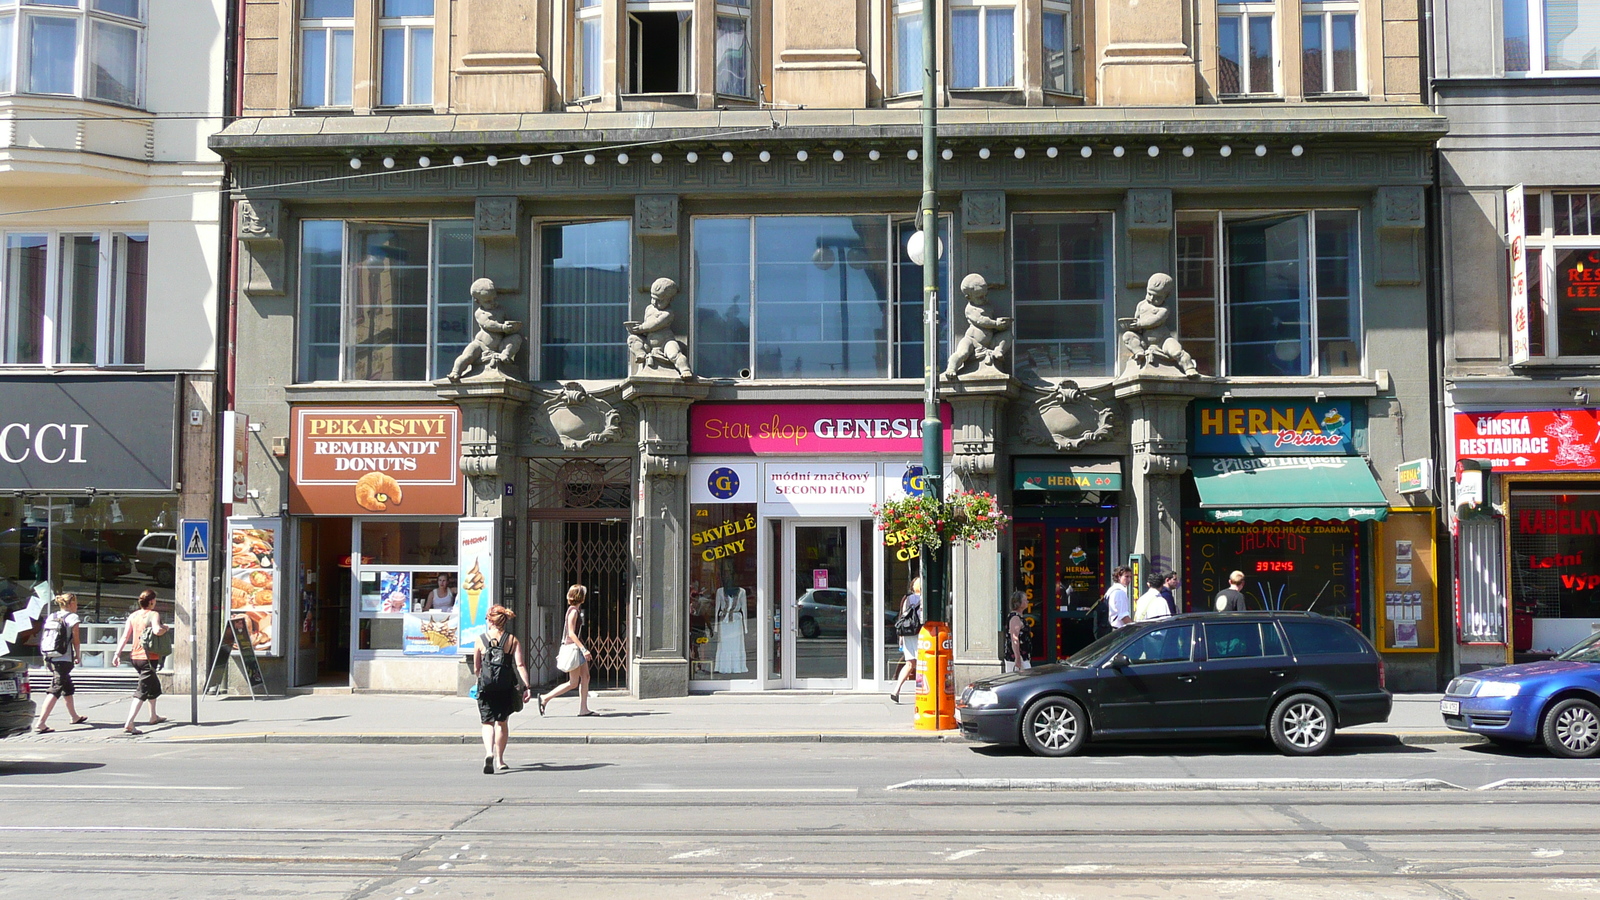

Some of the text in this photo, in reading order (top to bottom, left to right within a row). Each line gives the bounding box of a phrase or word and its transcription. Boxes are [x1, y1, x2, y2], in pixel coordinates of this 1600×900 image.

[309, 415, 446, 435] PEKAŘSTVÍ
[1200, 406, 1323, 436] HERNA
[1476, 416, 1531, 435] ČÍNSKÁ
[704, 418, 752, 439] Star
[758, 414, 808, 446] shop
[1274, 429, 1342, 448] Primo
[0, 422, 89, 464] CCI
[314, 441, 440, 455] REMBRANDT
[1459, 438, 1549, 455] RESTAURACE
[335, 457, 417, 471] DONUTS
[715, 476, 732, 491] G
[771, 471, 870, 484] módní značkový
[1047, 476, 1091, 487] HERNA
[1400, 468, 1418, 484] HERNA
[507, 485, 513, 494] 21
[775, 485, 865, 495] SECOND HAND
[696, 509, 709, 517] za
[691, 513, 757, 546] SKVĚLÉ
[1192, 526, 1215, 534] KÁVA
[1225, 526, 1259, 534] NEALKO
[1263, 526, 1280, 534] PRO
[1282, 525, 1311, 534] HRÁČE
[1313, 526, 1351, 534] ZDARMA
[702, 539, 746, 562] CENY
[1235, 530, 1307, 555] JACKPOT
[1529, 550, 1584, 569] Letní
